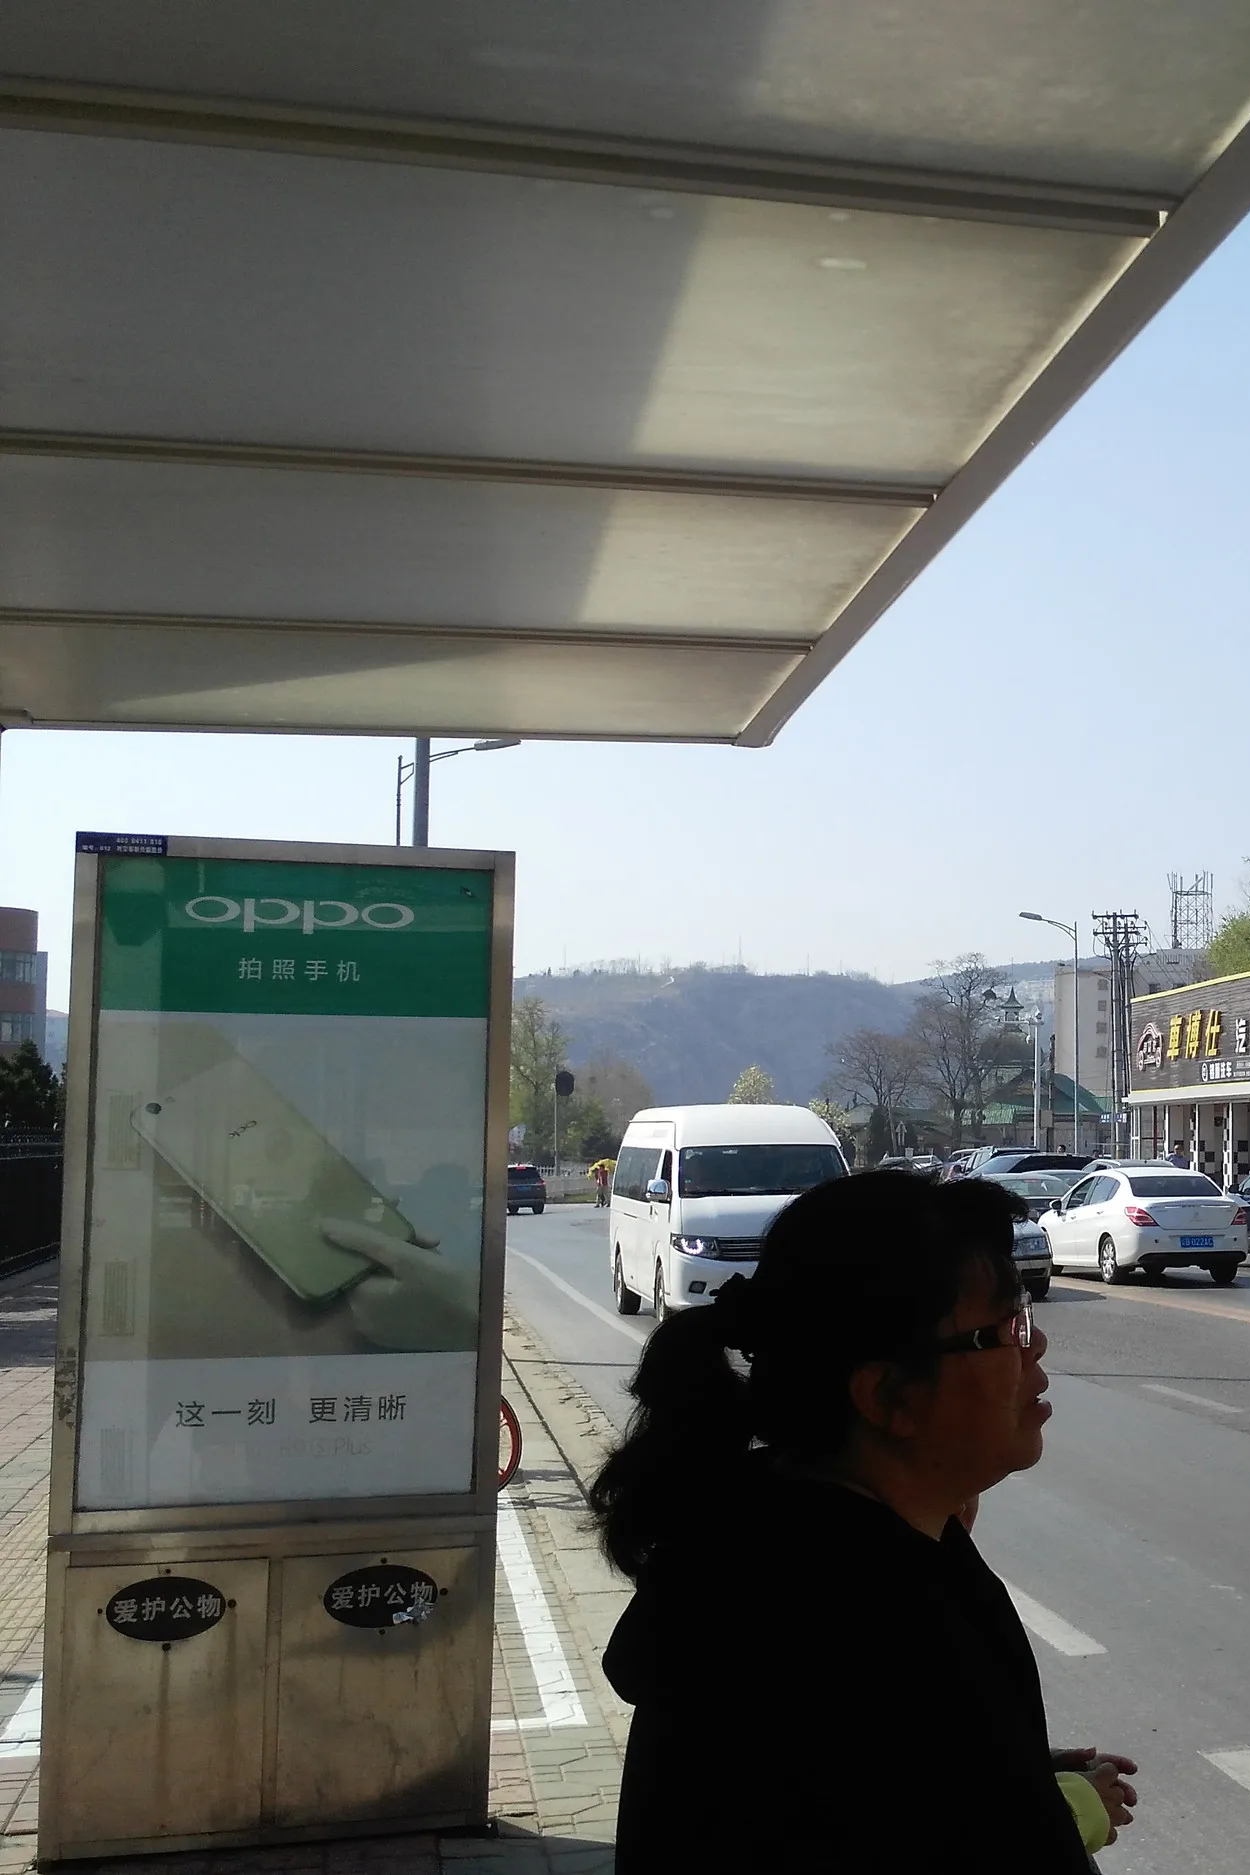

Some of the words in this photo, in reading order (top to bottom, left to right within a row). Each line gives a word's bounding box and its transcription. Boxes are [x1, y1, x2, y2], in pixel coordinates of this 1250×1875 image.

[238, 957, 361, 983] 拍照手机
[175, 1399, 276, 1428] 这一刻
[309, 1394, 407, 1424] 更清晰
[113, 1596, 222, 1625] 爱护公物
[330, 1580, 435, 1612] 爱护公物
